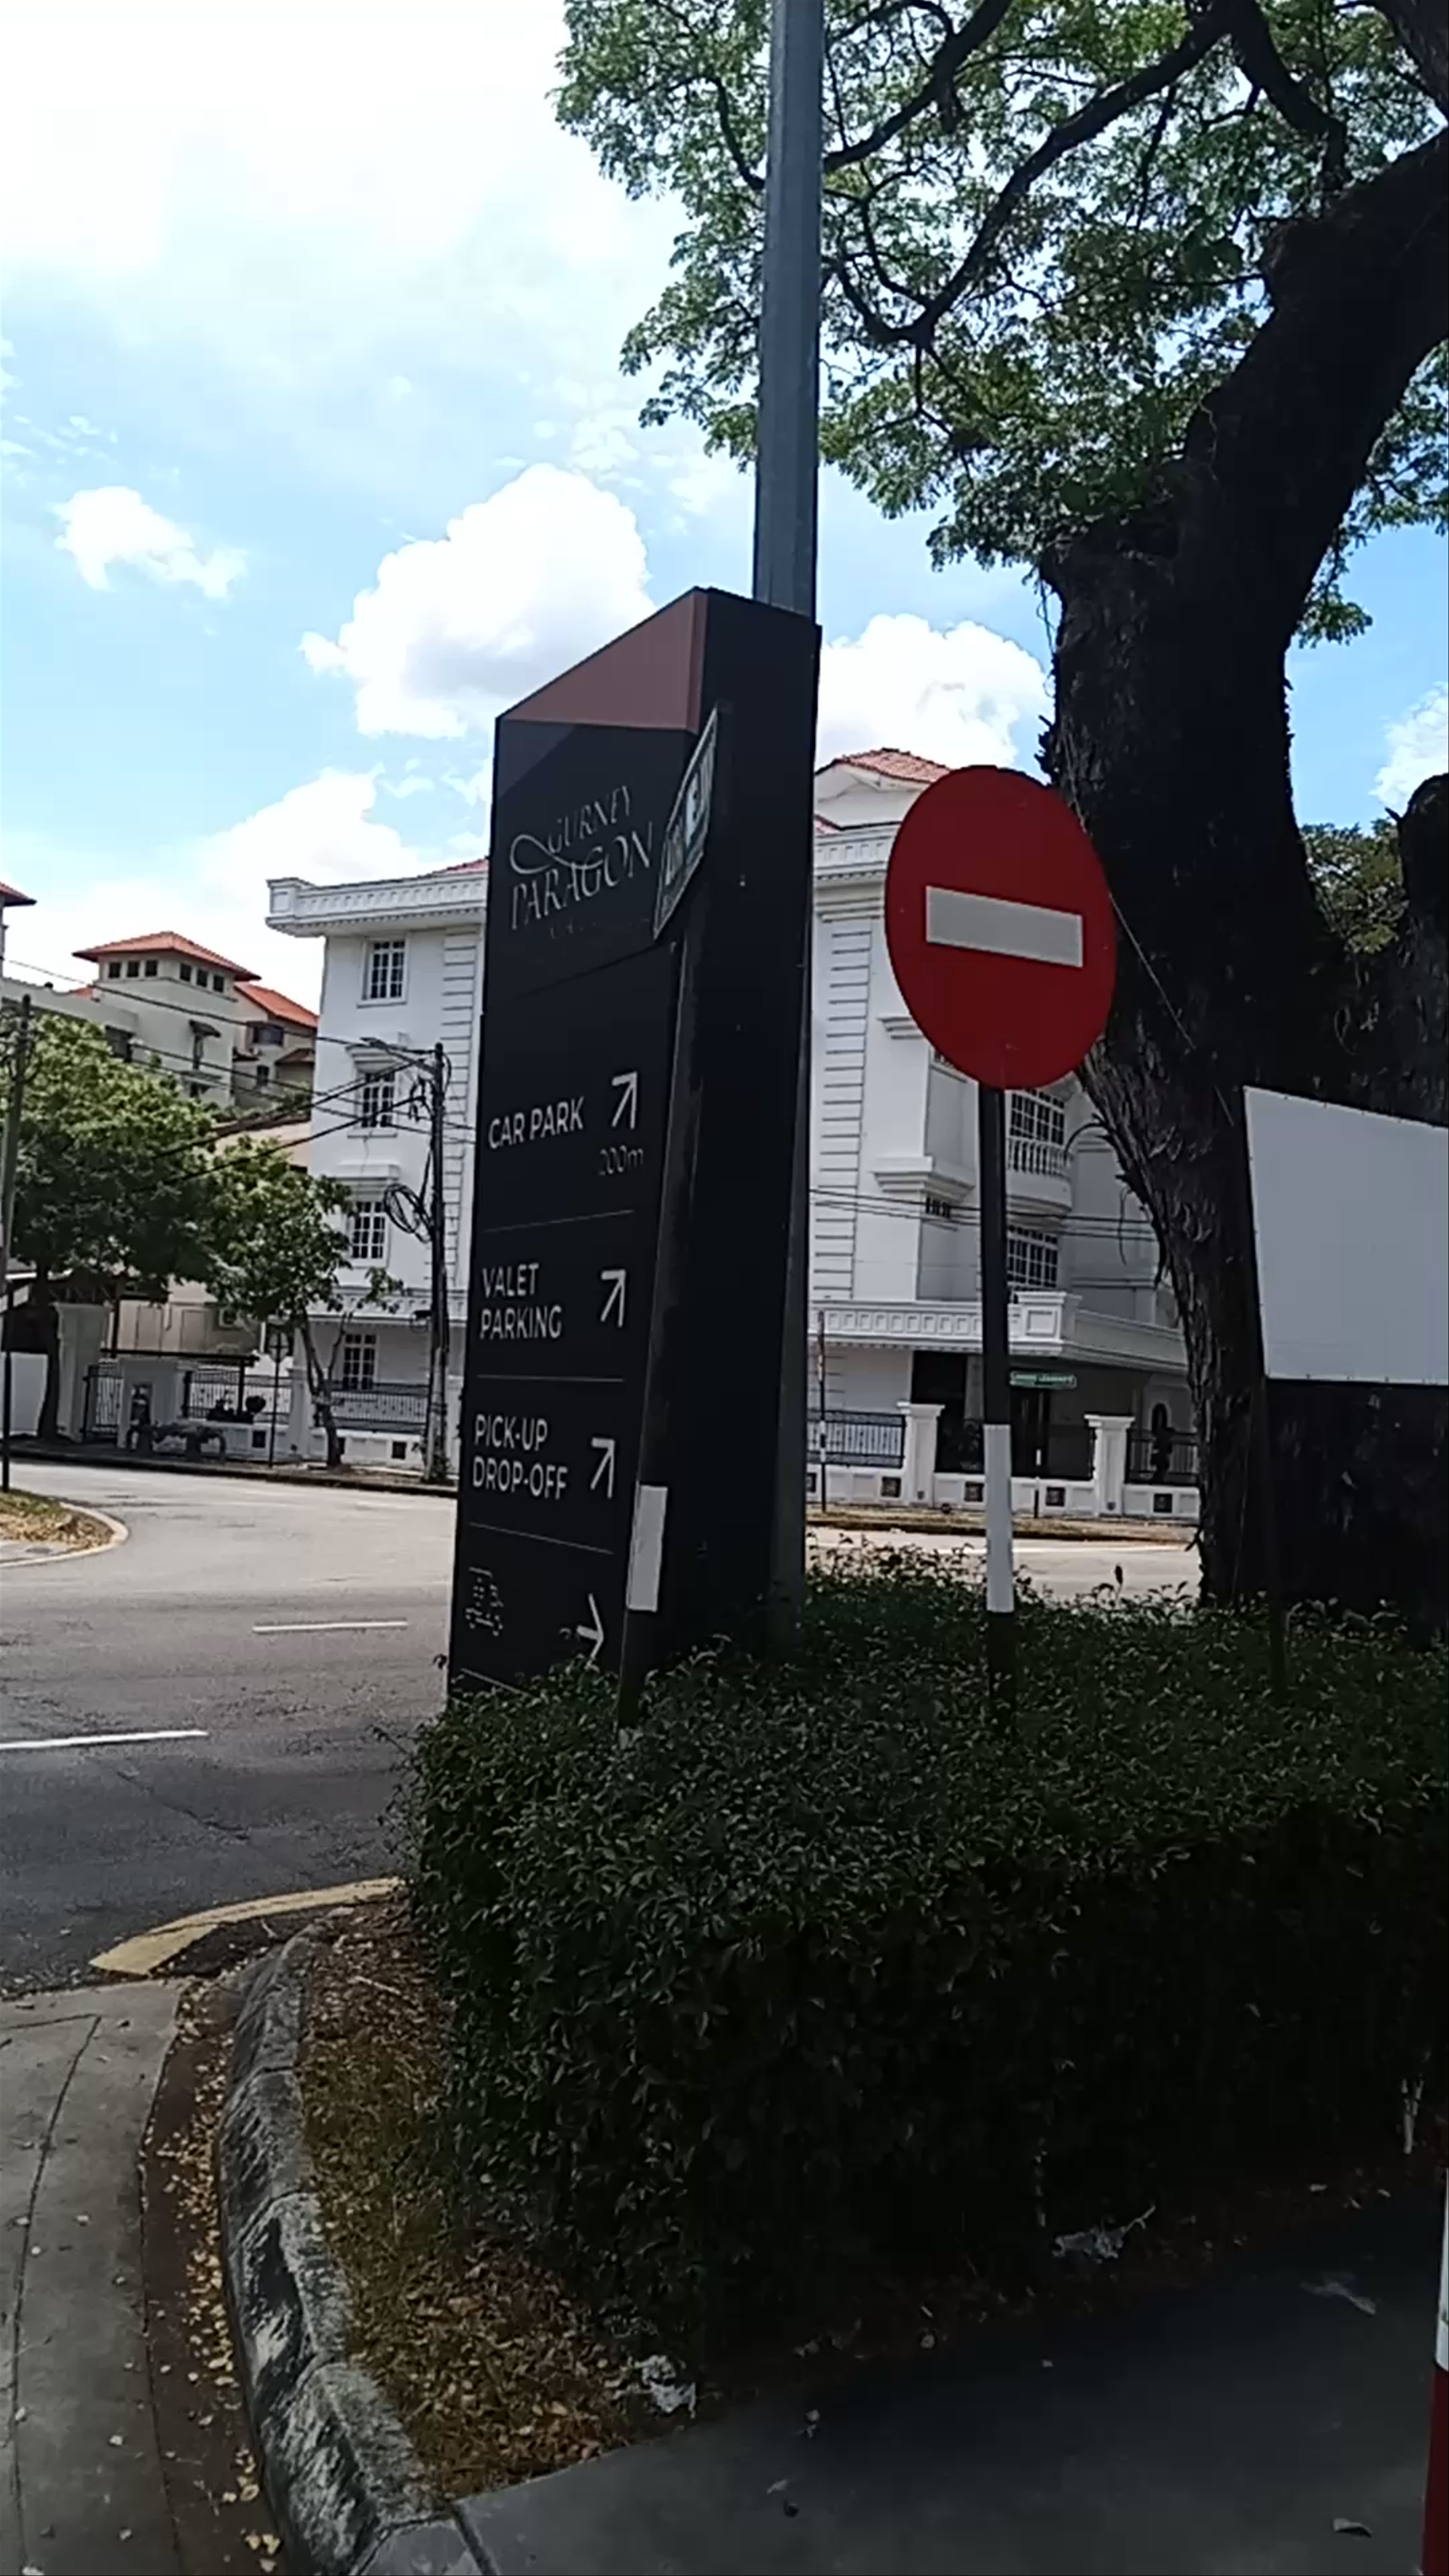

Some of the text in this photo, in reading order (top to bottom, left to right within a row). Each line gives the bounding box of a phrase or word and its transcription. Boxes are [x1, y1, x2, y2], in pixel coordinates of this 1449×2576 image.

[512, 821, 654, 930] PARAGON
[488, 1096, 585, 1149] CAR PARK
[482, 1263, 539, 1298] VALET
[480, 1305, 562, 1340] PARKING
[474, 1414, 548, 1451] PICK-UP
[472, 1456, 568, 1499] DROP-OFF
